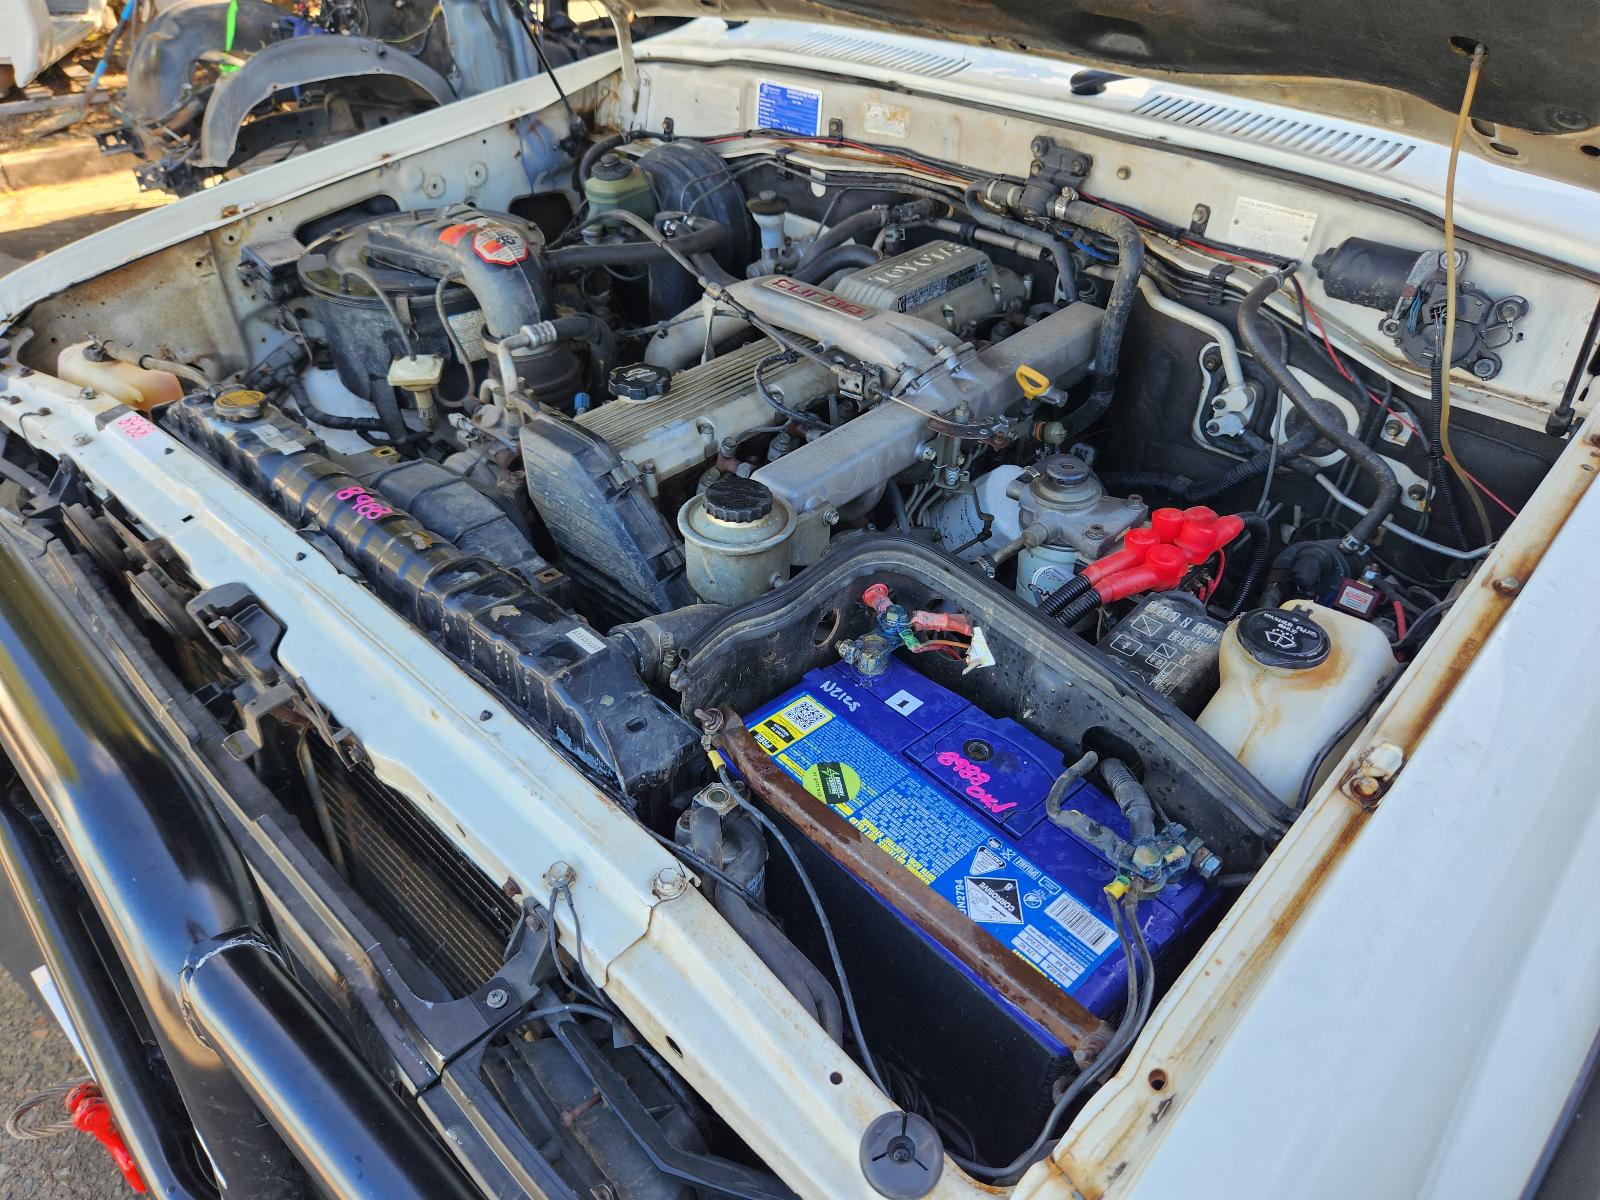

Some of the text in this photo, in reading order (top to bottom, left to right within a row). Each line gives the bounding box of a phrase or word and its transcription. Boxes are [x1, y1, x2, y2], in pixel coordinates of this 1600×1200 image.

[752, 732, 773, 748] FREE
[1014, 857, 1039, 878] SPILLABLE
[1002, 881, 1014, 891] 8
[977, 880, 1016, 912] CORROSIVE
